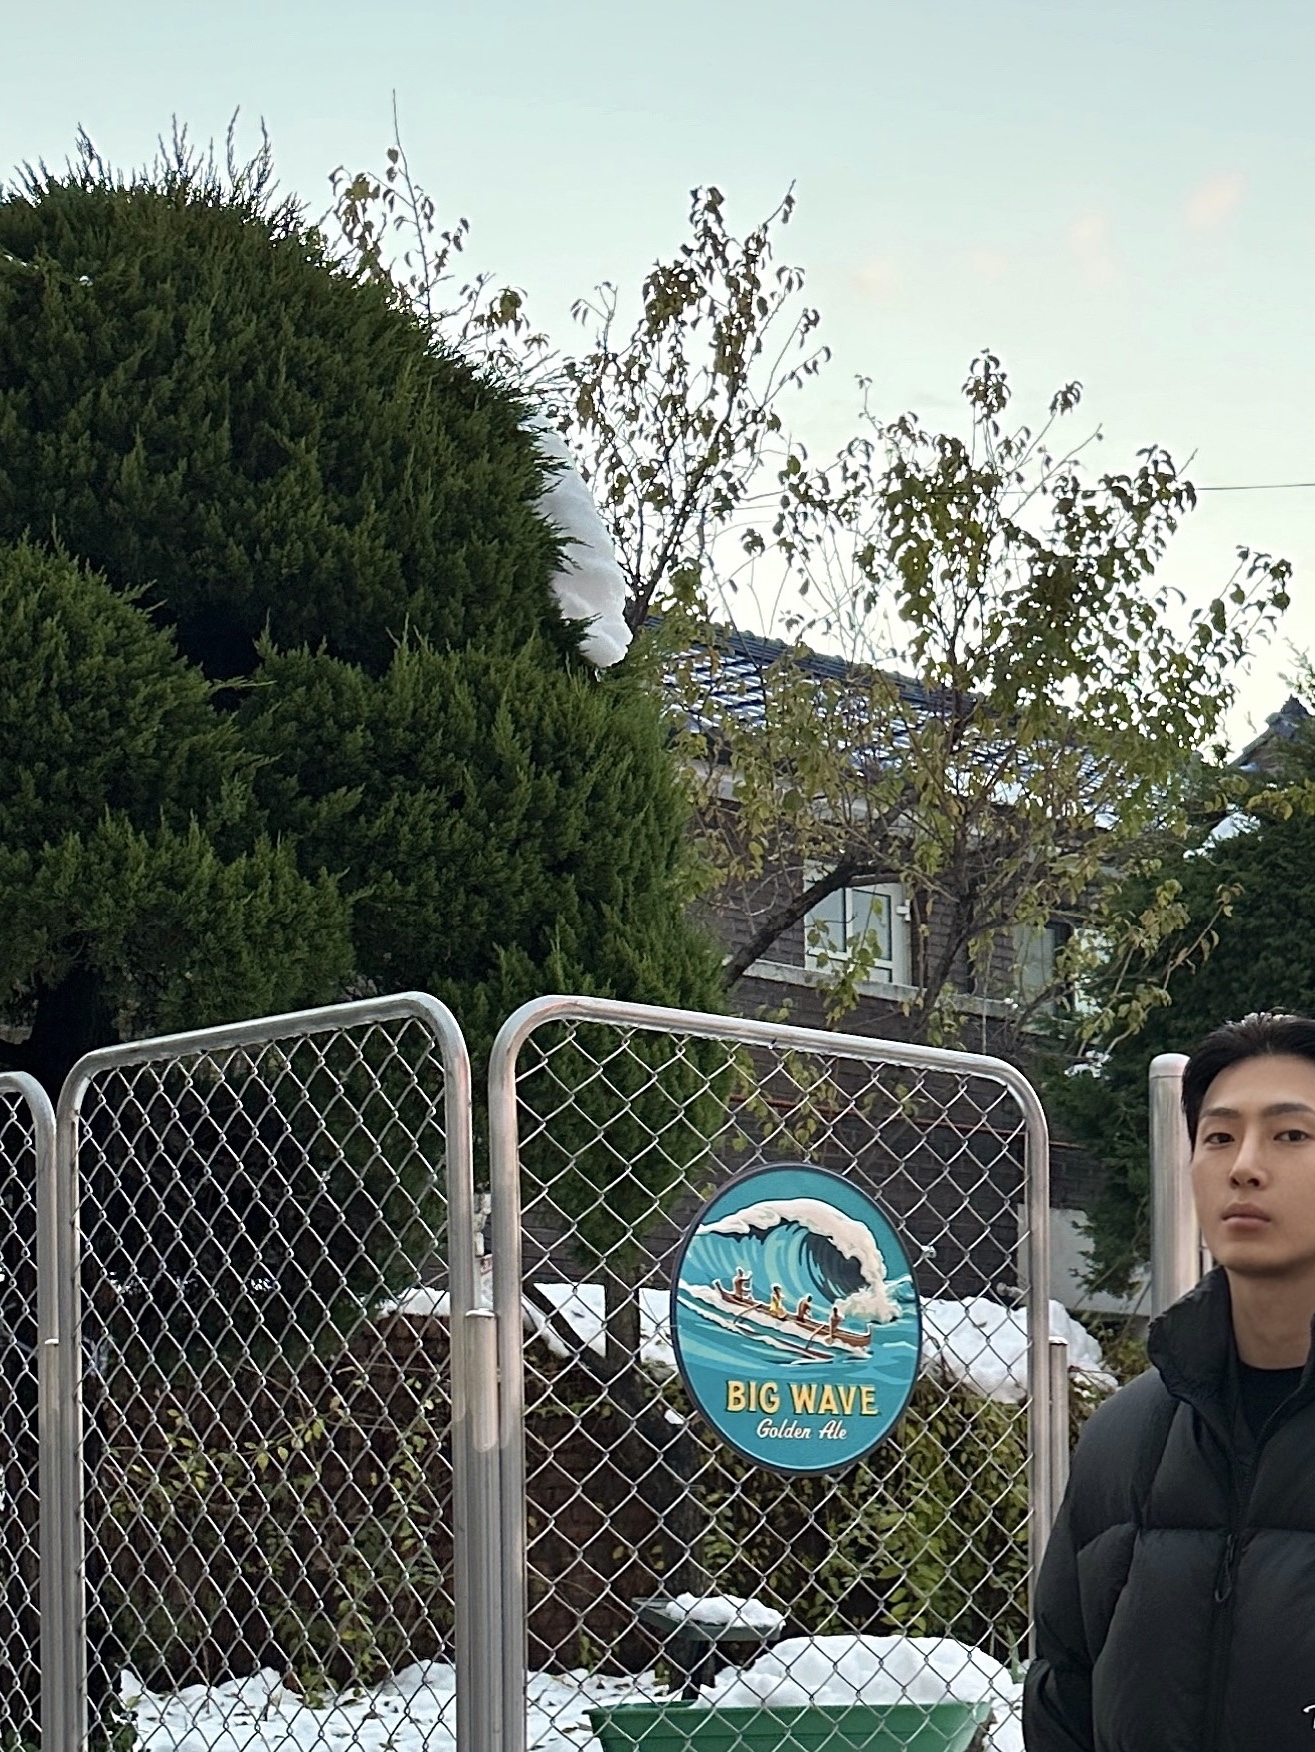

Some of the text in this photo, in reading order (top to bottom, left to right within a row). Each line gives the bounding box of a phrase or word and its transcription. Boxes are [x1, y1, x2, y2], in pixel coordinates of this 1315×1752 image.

[726, 1379, 880, 1416] BIG WAVE
[756, 1417, 848, 1440] Golden Ale
